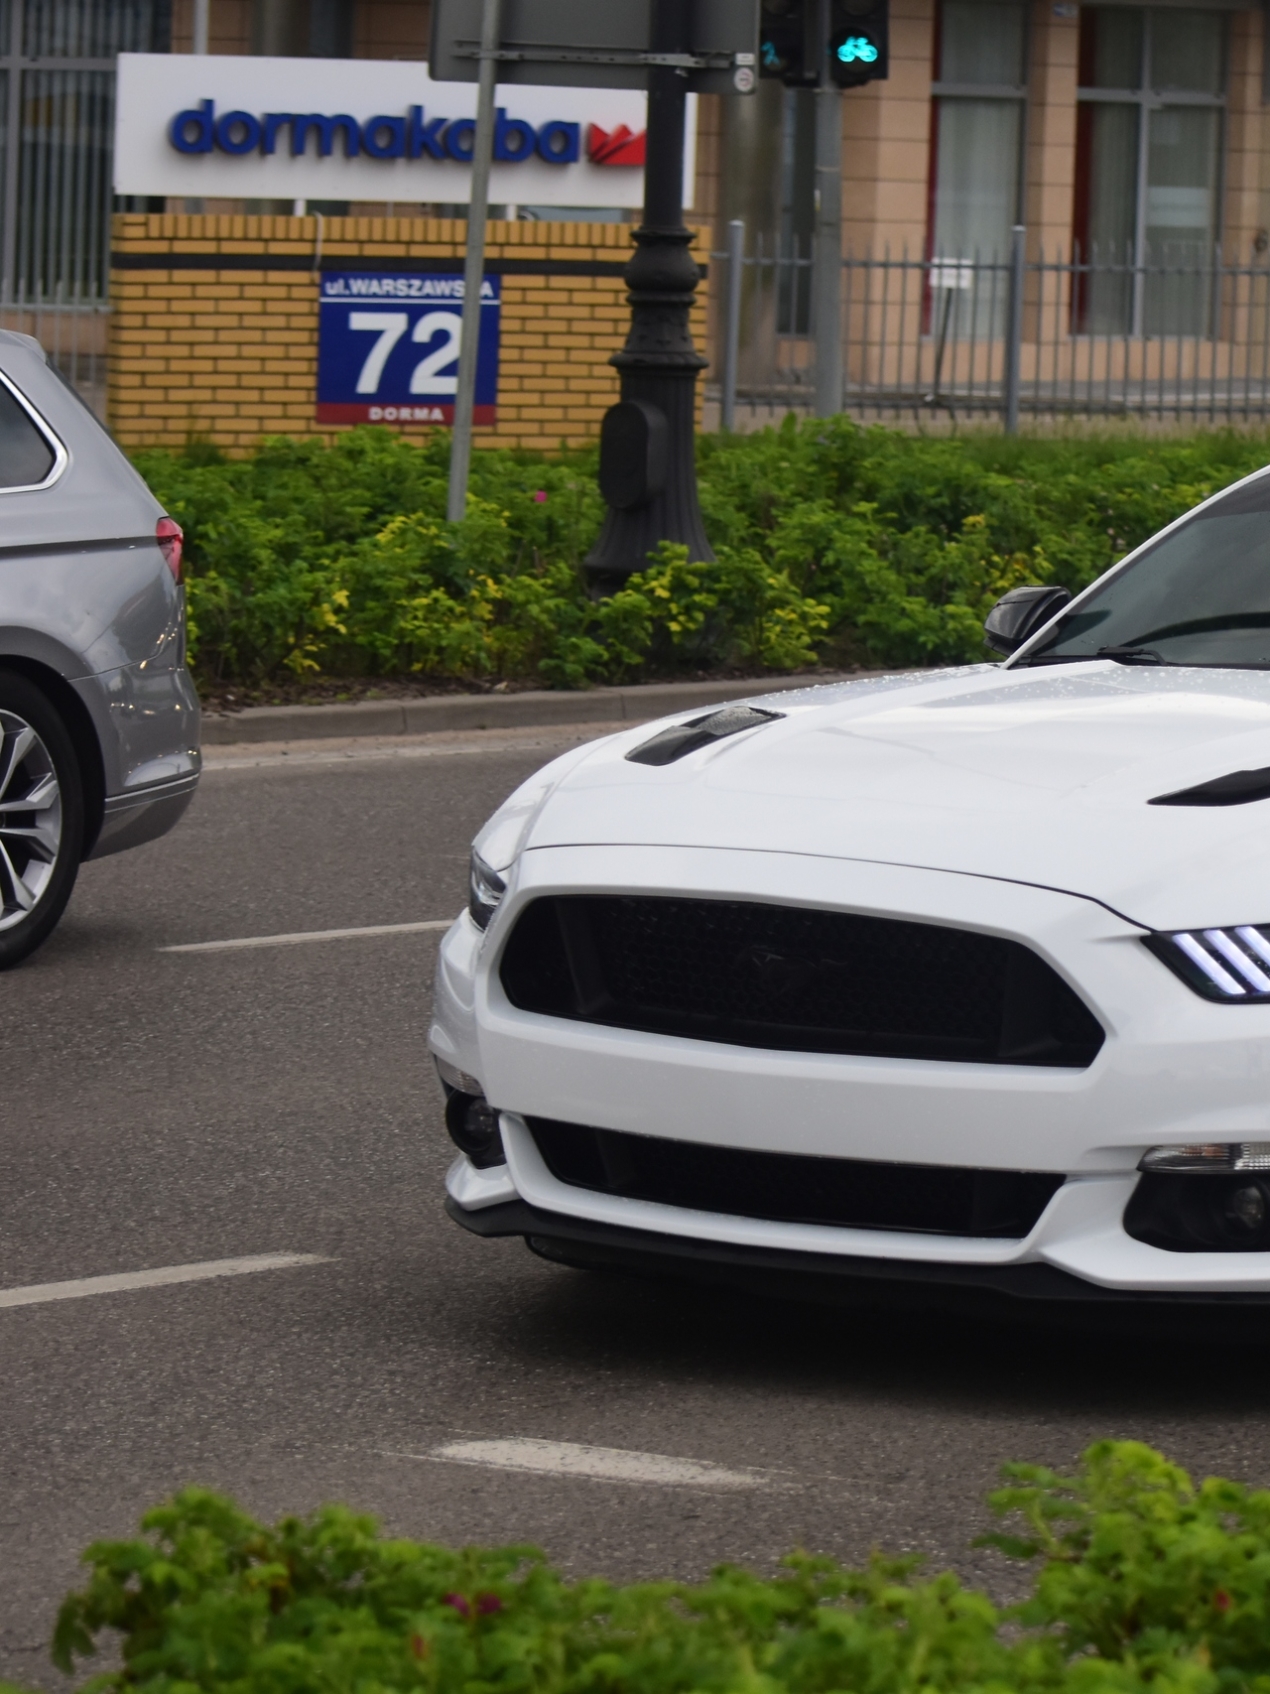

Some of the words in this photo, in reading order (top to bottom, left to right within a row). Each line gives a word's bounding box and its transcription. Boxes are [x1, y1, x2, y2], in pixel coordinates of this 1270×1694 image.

[170, 98, 580, 165] dormakaba
[349, 311, 463, 394] 72
[368, 406, 444, 421] DORMA
